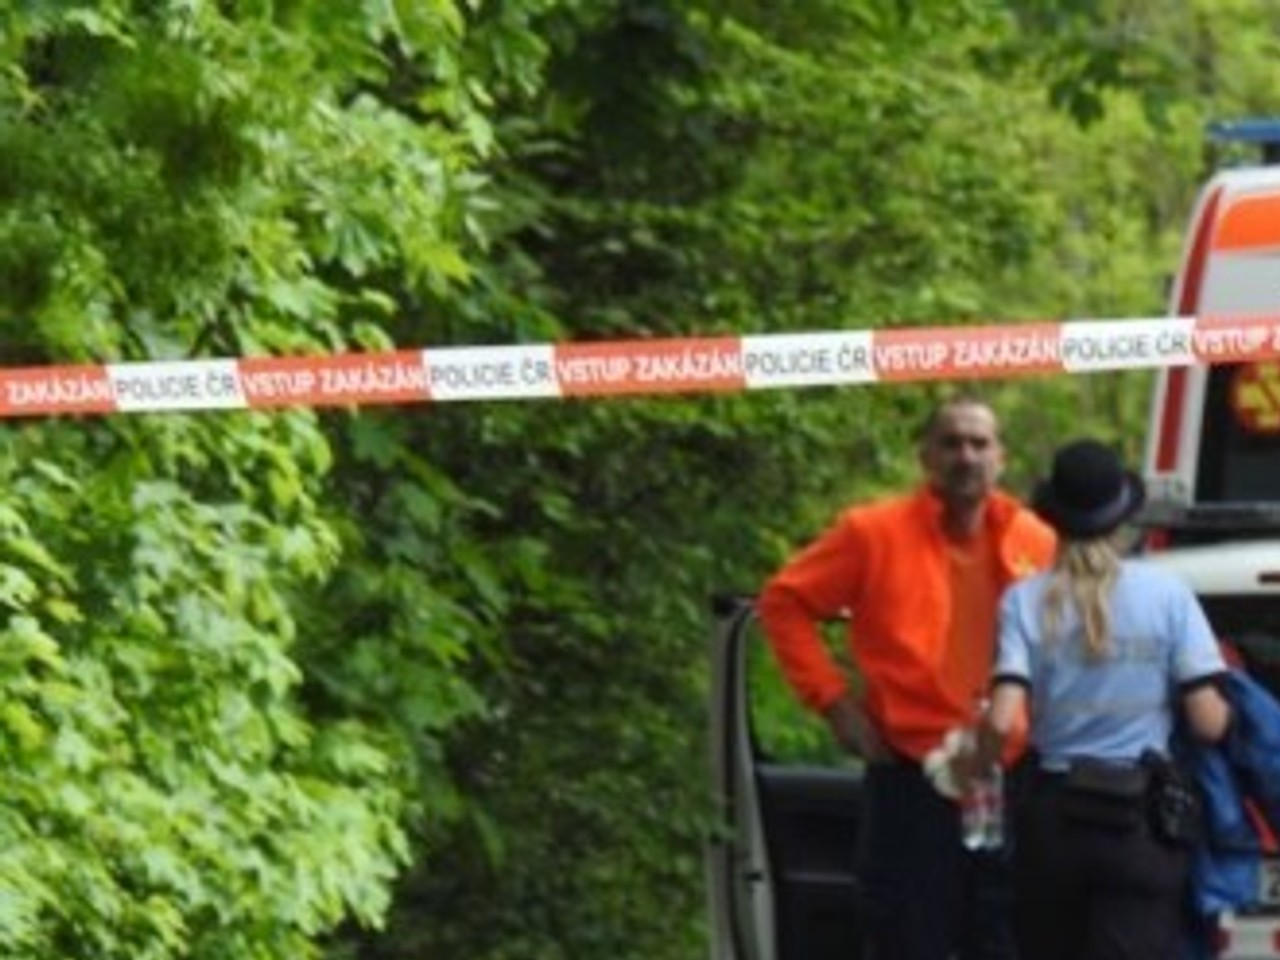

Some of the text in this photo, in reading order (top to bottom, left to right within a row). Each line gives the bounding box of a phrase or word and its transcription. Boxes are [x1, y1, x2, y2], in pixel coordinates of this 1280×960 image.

[5, 374, 111, 405] ZAKÁZÁN
[117, 374, 199, 400] POLICIE
[205, 369, 235, 397] ČR
[244, 371, 314, 398] VSTUP
[321, 362, 425, 394] ZAKÁZÁN
[432, 361, 514, 388] POLICIE
[520, 357, 551, 385] ČR
[559, 356, 631, 384] VSTUP
[636, 346, 740, 380] ZAKÁZÁN
[746, 348, 827, 375] POLICIE
[837, 344, 868, 371] ČR
[876, 343, 948, 371] VSTUP
[954, 333, 1058, 367] ZAKÁZÁN
[1064, 334, 1150, 361] POLICIE
[1156, 329, 1187, 356] ČR
[1194, 326, 1267, 355] VSTUP
